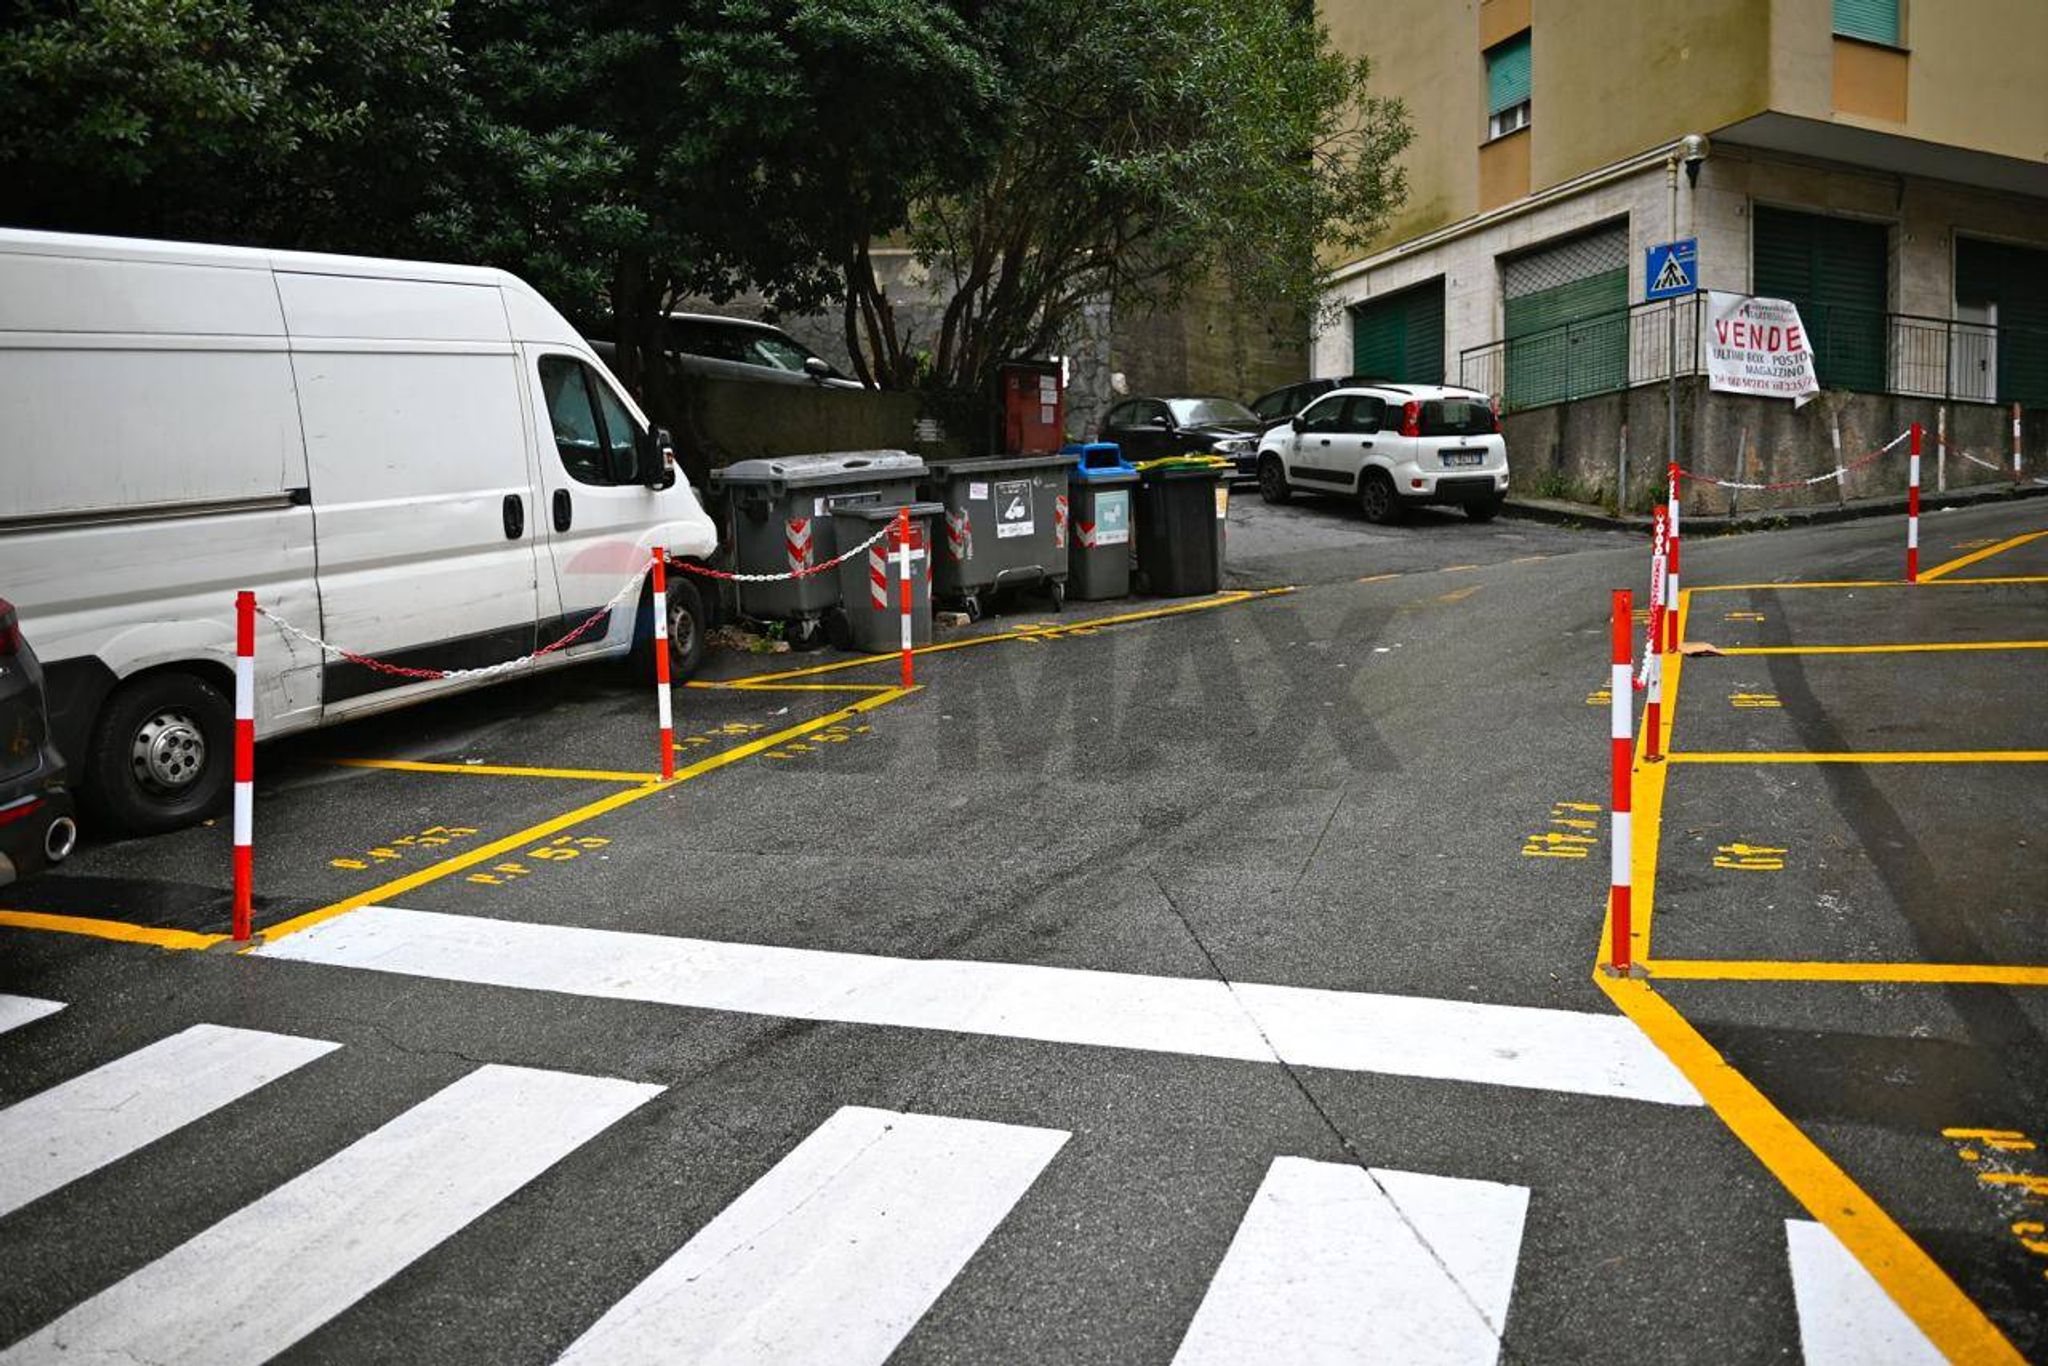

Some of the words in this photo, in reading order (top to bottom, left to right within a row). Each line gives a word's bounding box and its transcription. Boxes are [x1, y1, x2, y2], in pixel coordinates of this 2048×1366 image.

[1715, 319, 1802, 352] VENDE
[1747, 352, 1764, 364] BOX
[1745, 364, 1804, 379] MAGAZZINO
